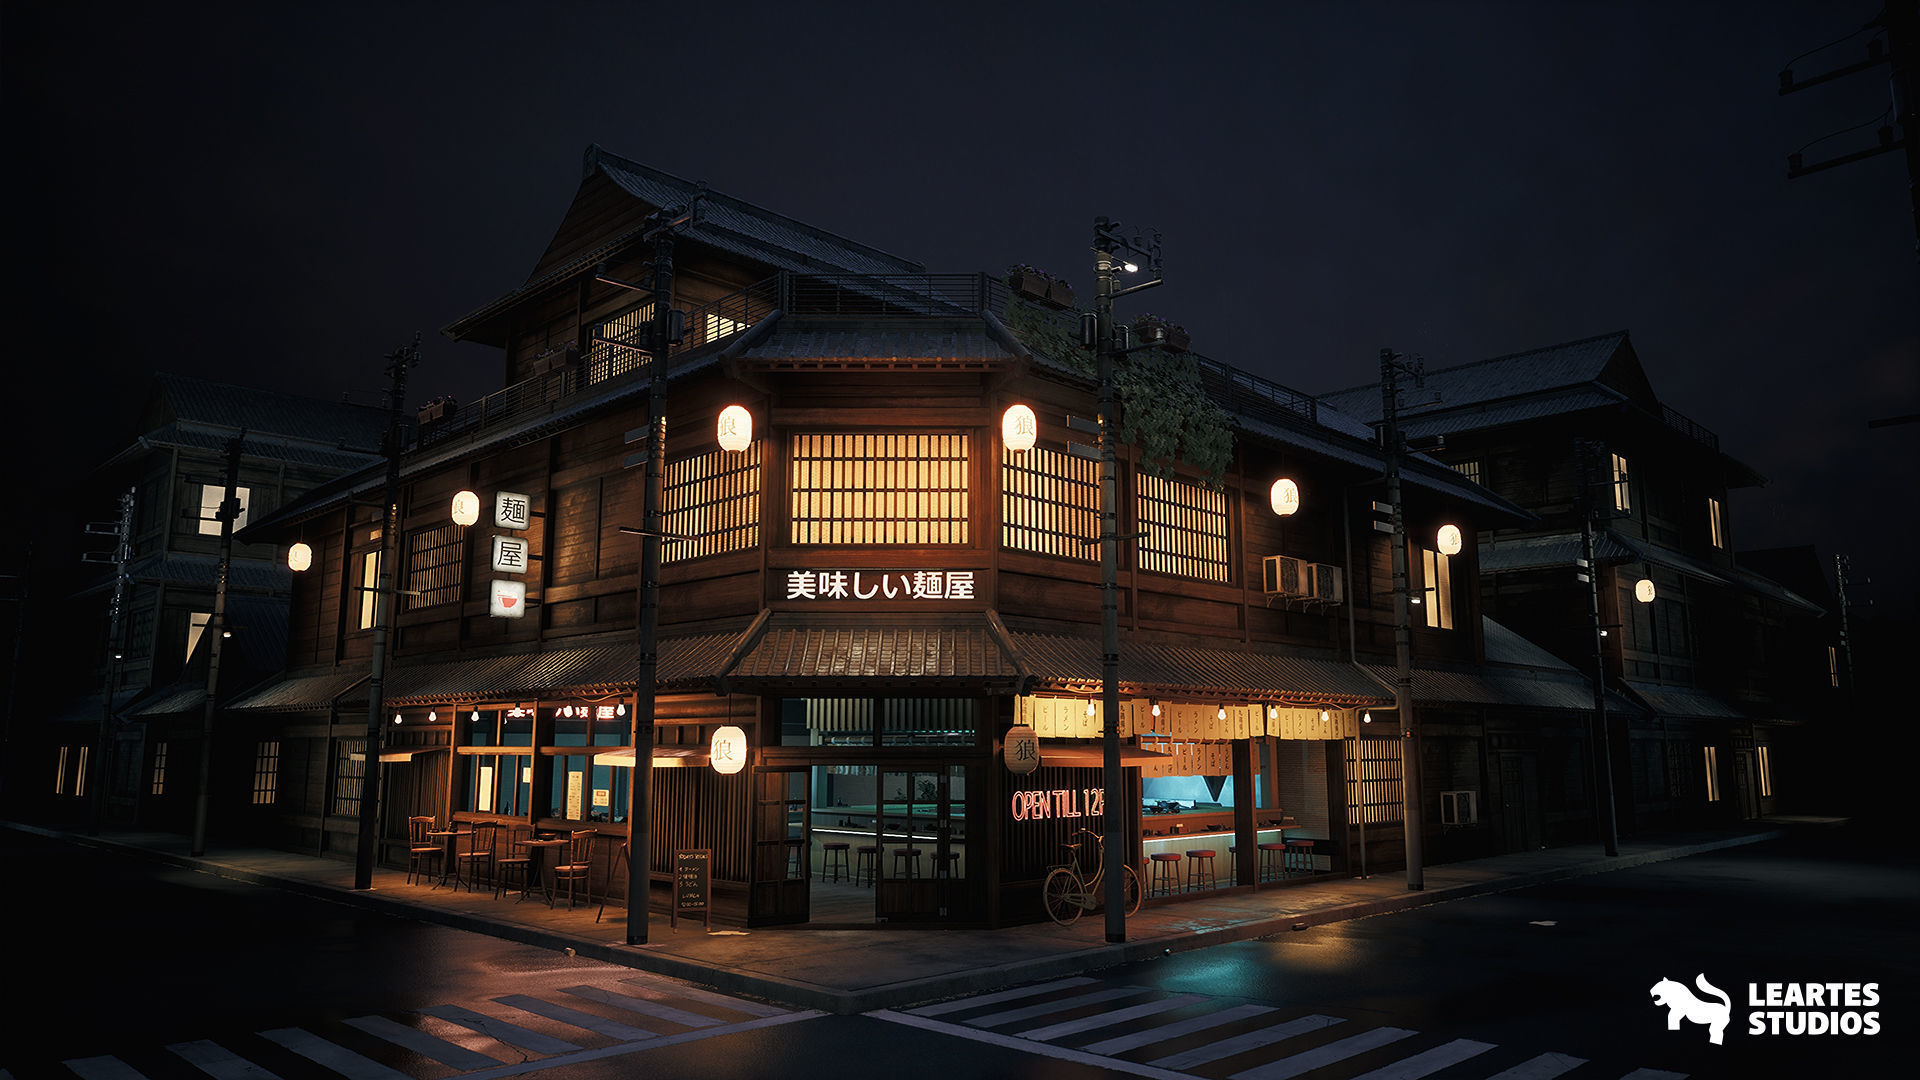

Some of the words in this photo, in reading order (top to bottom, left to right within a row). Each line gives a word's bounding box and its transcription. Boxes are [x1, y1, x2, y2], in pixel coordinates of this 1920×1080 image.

[787, 570, 975, 600] 美味しい麺屋
[1015, 739, 1037, 761] 狼
[1012, 790, 1051, 821] OPEN
[1052, 789, 1081, 818] TILL
